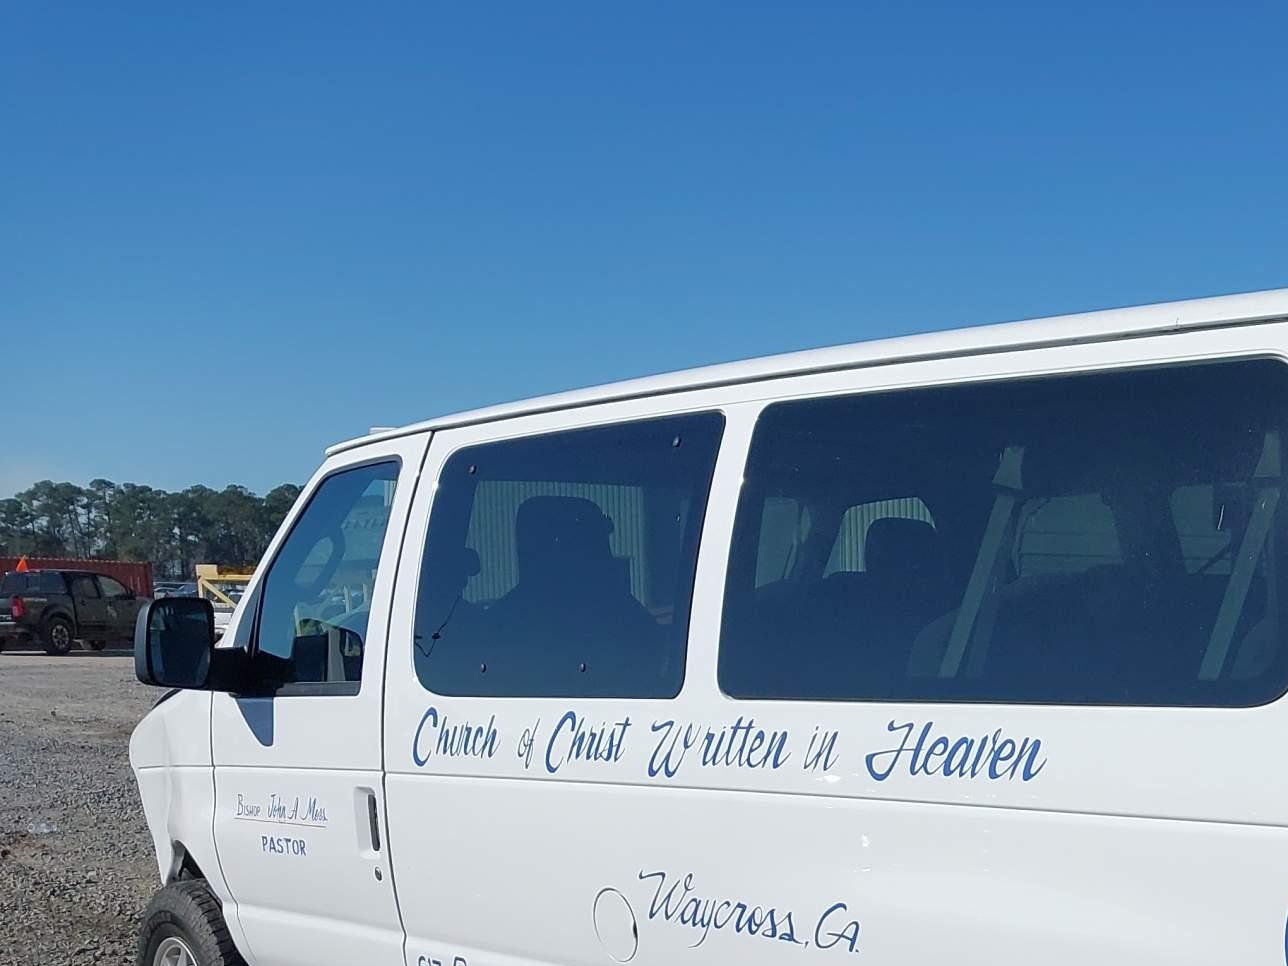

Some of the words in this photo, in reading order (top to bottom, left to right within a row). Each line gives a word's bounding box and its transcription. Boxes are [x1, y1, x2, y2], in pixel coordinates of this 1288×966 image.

[412, 706, 500, 767] Church
[517, 717, 541, 769] of
[545, 710, 632, 773] Christ
[648, 715, 792, 778] Written
[803, 725, 839, 772] in
[865, 719, 1048, 781] Heaven
[288, 796, 300, 820] A
[261, 835, 307, 857] PASTOR
[638, 869, 810, 949] Waycross,
